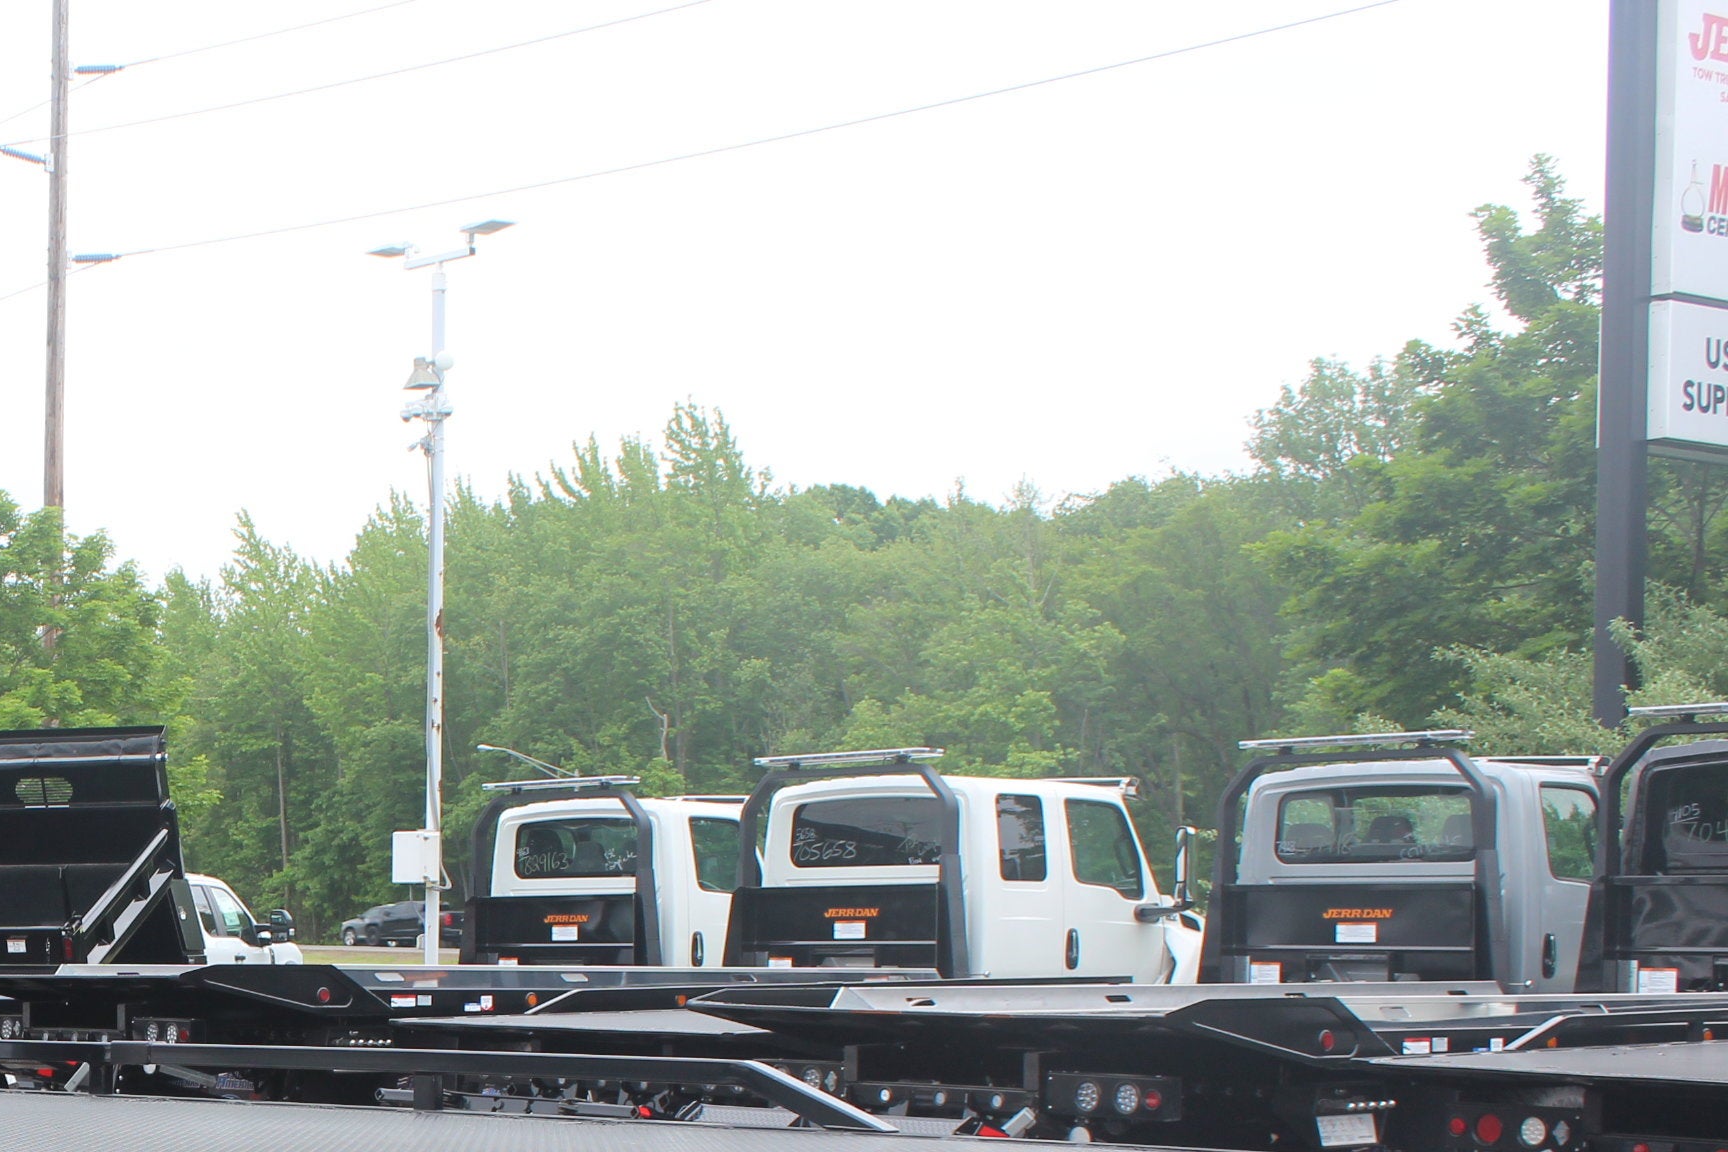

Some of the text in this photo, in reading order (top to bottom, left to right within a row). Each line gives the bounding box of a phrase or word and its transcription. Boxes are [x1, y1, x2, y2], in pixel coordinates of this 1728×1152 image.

[1692, 66, 1714, 82] TOW
[1707, 215, 1728, 237] CE
[1682, 379, 1728, 416] SUP
[824, 908, 880, 918] JERR-DAN
